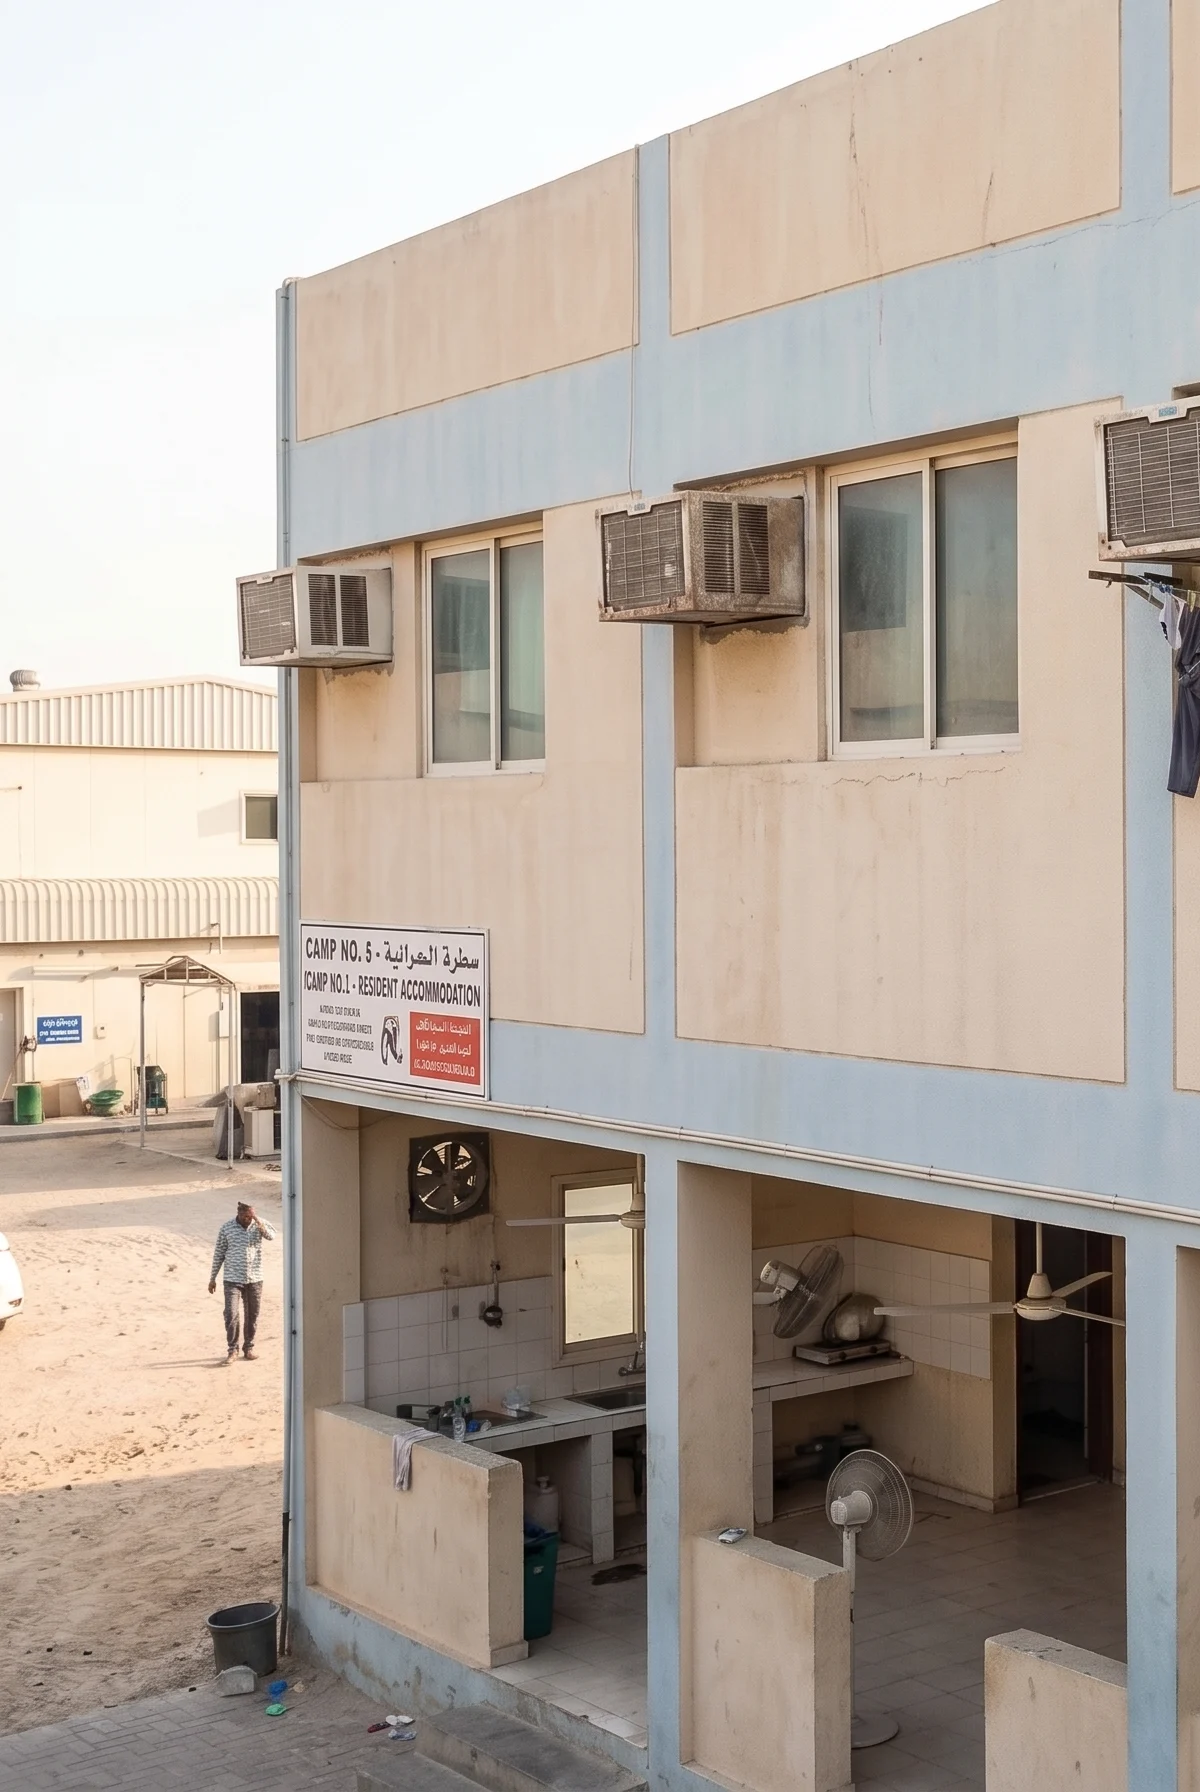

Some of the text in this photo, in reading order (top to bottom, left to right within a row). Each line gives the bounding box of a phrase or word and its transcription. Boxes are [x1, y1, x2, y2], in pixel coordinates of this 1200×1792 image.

[306, 937, 336, 960] CAMP
[341, 939, 362, 962] NO.
[366, 941, 372, 963] 5
[359, 975, 398, 999] RESIDENT
[400, 979, 481, 1007] ACCOMMODATION
